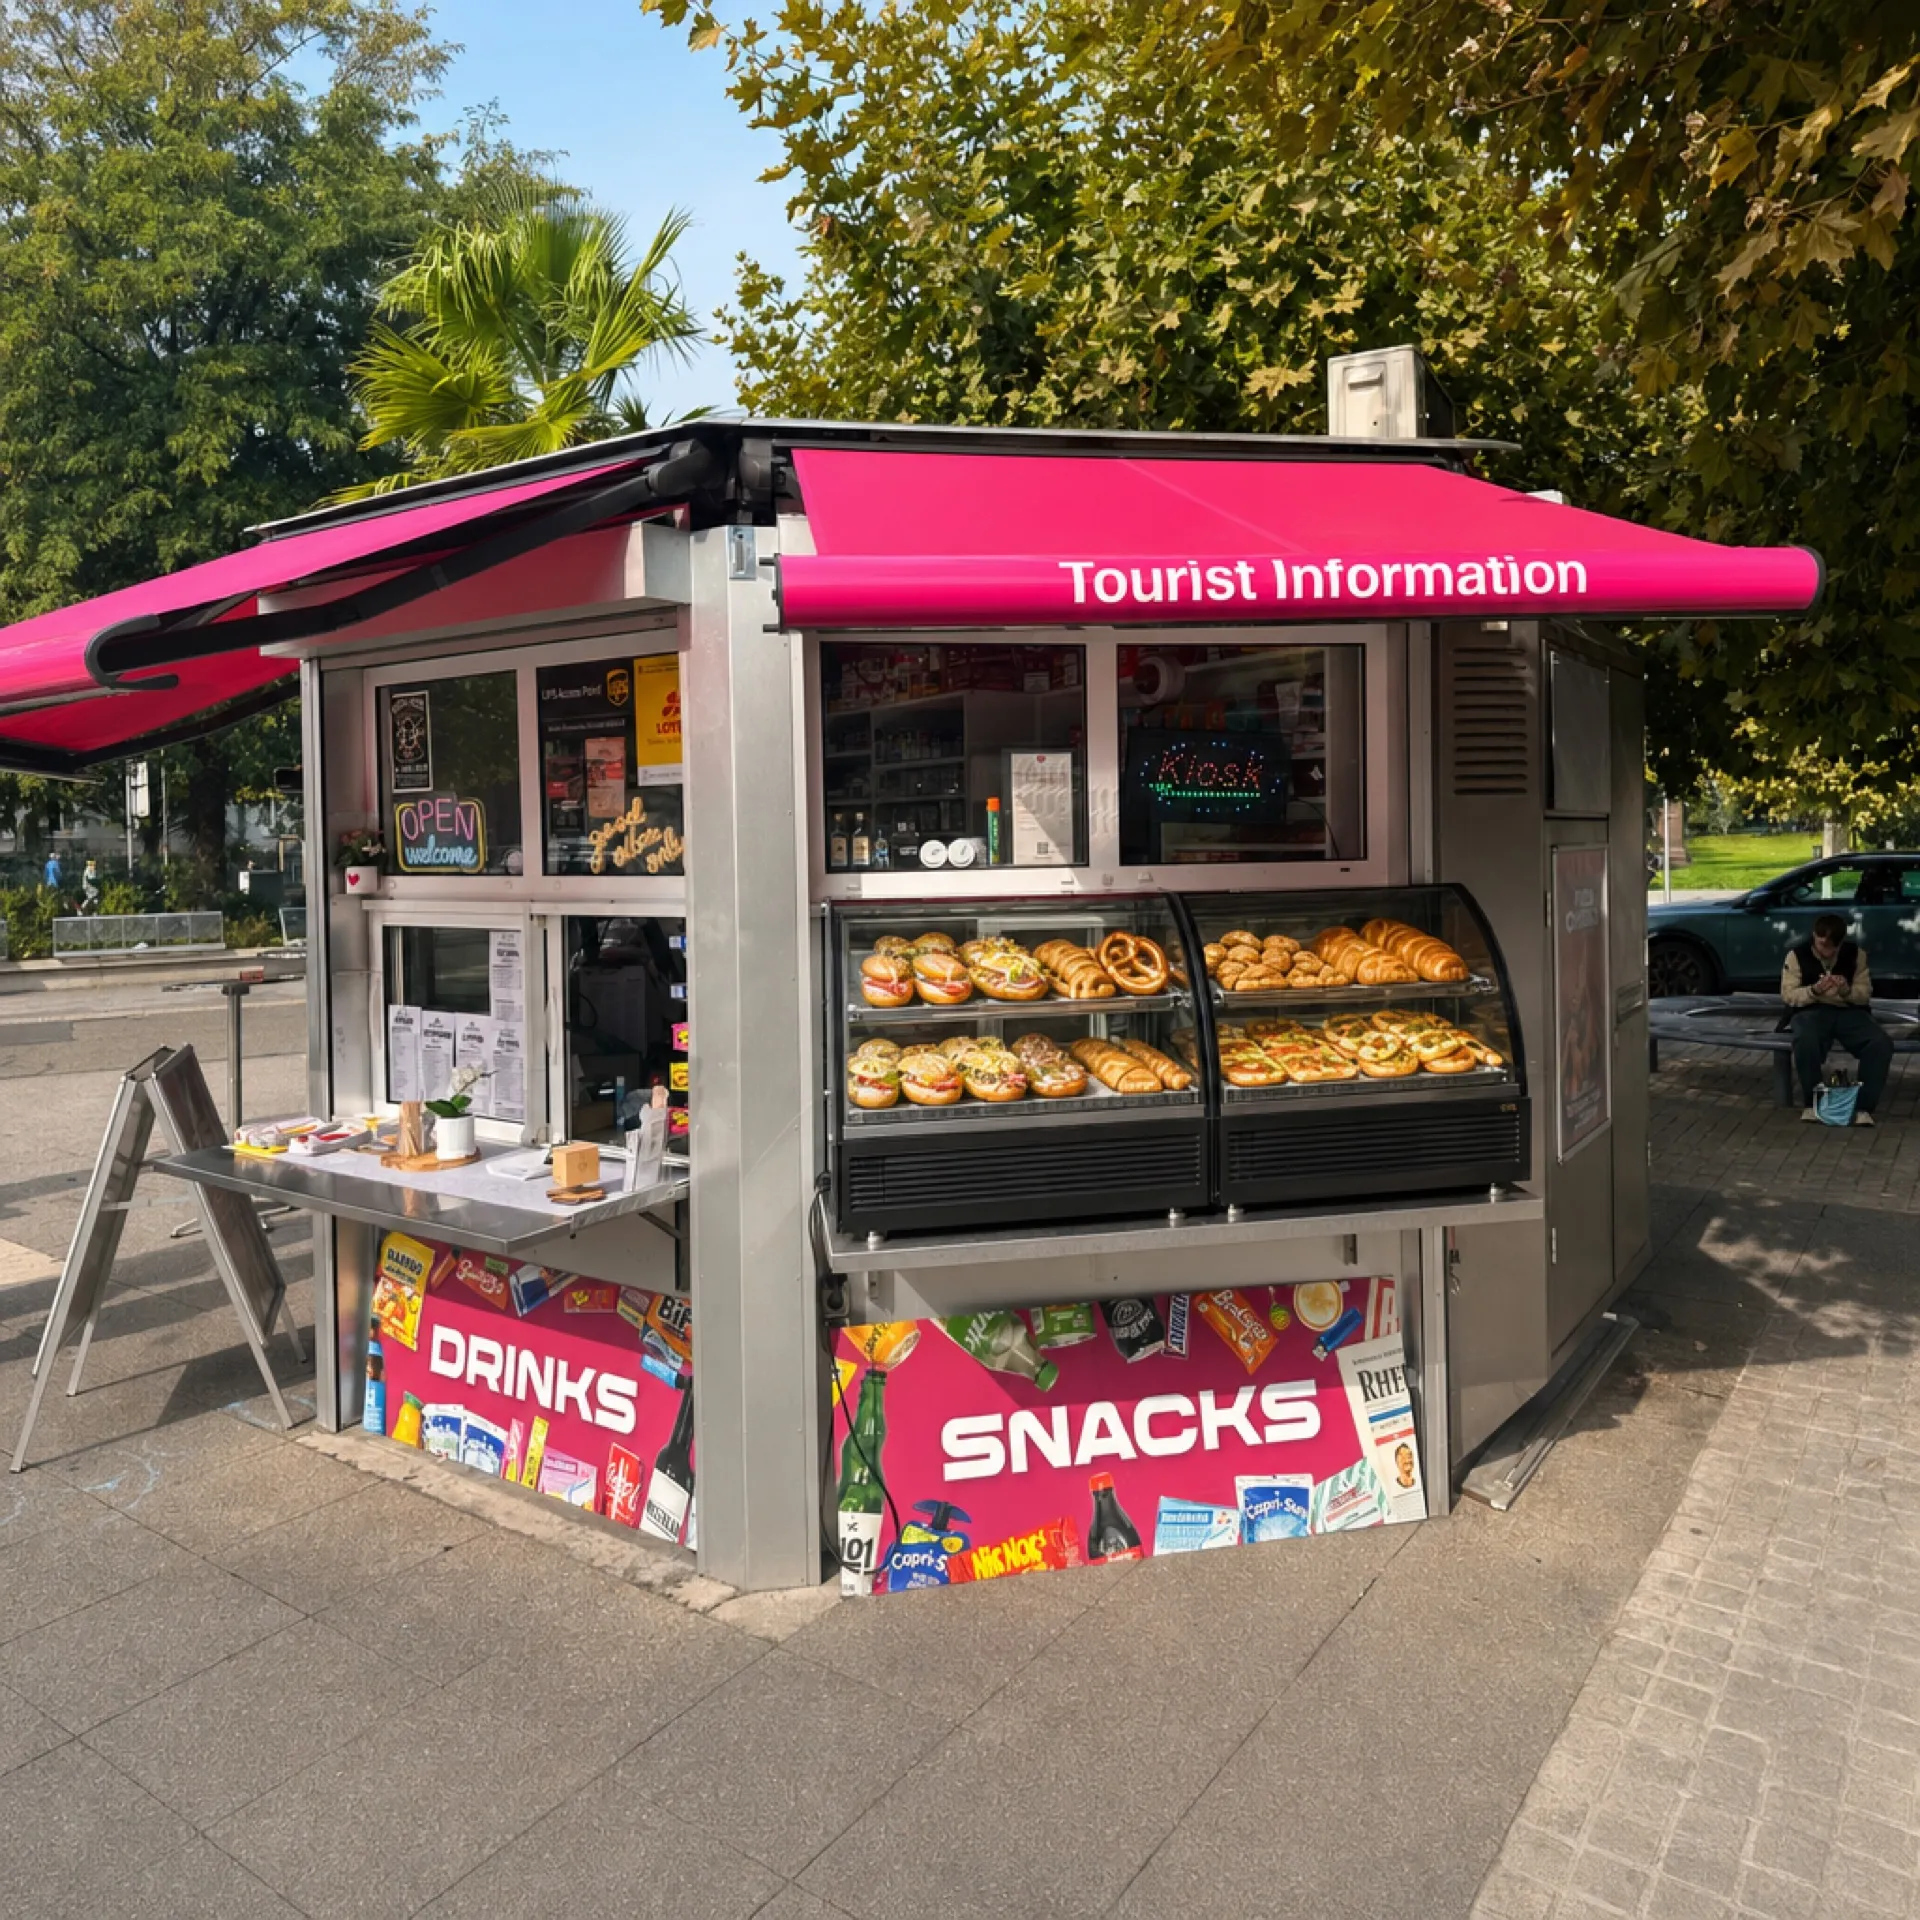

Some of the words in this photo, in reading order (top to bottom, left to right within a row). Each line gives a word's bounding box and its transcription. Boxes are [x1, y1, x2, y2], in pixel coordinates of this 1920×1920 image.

[1058, 560, 1256, 604] Tourist
[1272, 554, 1588, 600] Information
[401, 798, 475, 842] OPEN
[404, 833, 478, 868] welcome
[429, 1323, 639, 1435] DRINKS
[940, 1379, 1322, 1483] SNACKS
